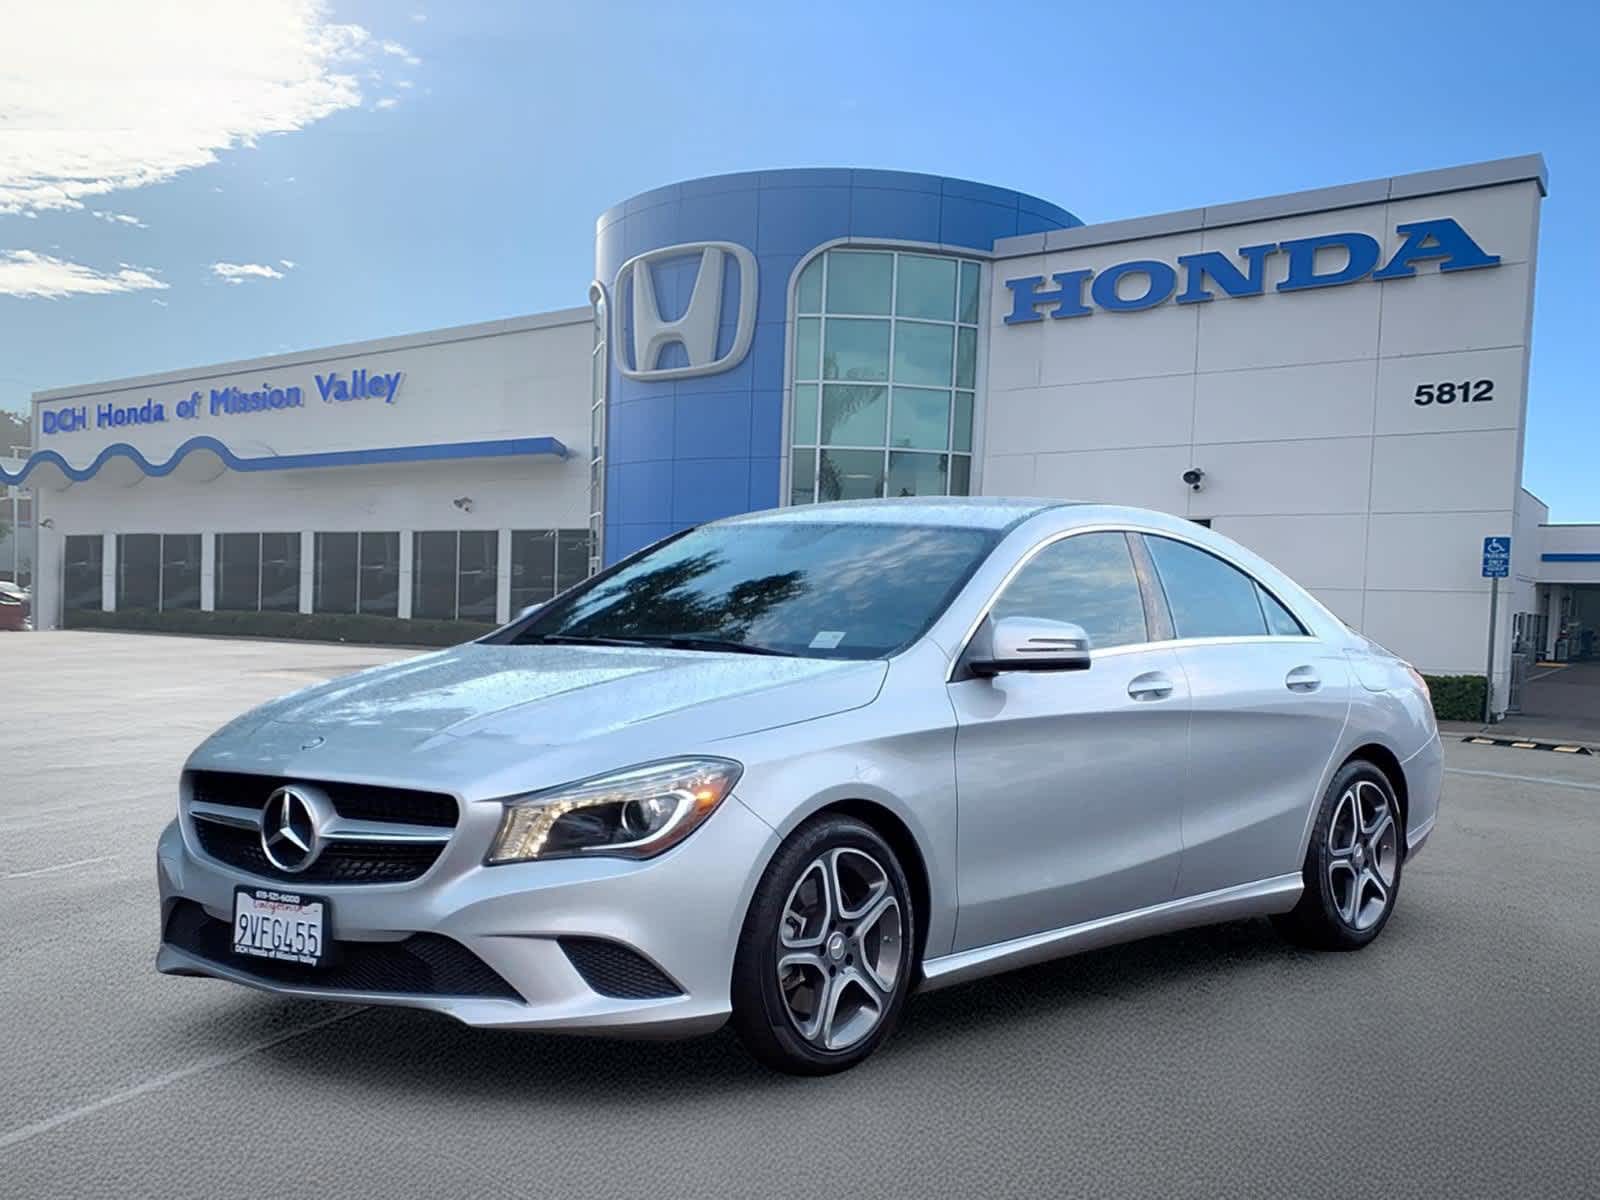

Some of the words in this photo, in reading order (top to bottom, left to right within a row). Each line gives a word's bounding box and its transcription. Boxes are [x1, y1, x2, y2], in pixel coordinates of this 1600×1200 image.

[1004, 218, 1500, 325] HONDA
[42, 406, 87, 434] DCH
[97, 399, 166, 428] Honda
[176, 392, 203, 419] of
[210, 382, 302, 416] Mission
[315, 369, 402, 404] Valley
[1414, 379, 1494, 406] 5812
[238, 914, 318, 955] 9VFG455
